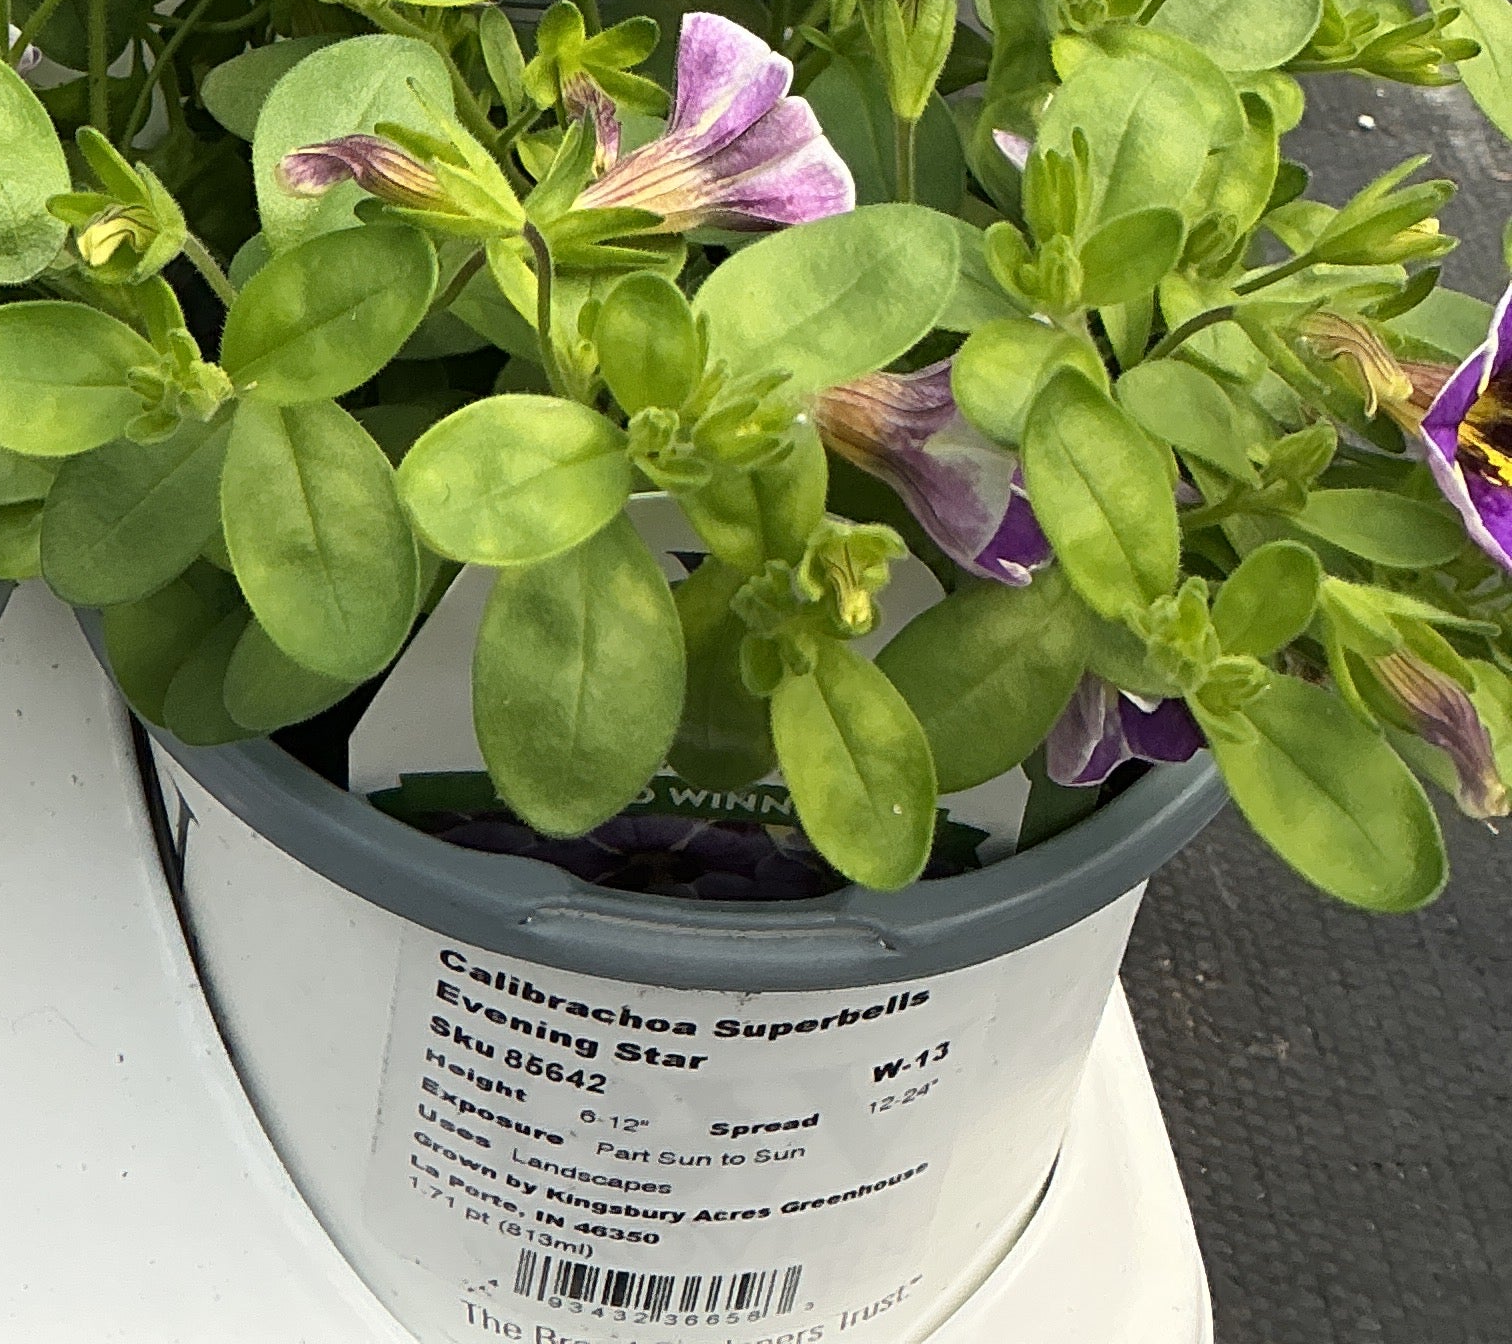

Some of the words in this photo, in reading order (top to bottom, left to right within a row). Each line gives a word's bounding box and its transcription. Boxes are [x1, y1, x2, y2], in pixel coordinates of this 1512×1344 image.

[669, 787, 791, 814] WINN
[436, 979, 599, 1059] Evening
[614, 1042, 708, 1069] Star
[439, 949, 697, 1036] Calibrachoa
[713, 990, 929, 1040] Superbells
[426, 1048, 527, 1102] Height
[709, 1113, 820, 1138] Spread
[430, 1015, 494, 1059] Sku
[504, 1049, 606, 1094] 85642
[873, 1041, 950, 1082] W-13
[418, 1103, 491, 1148] Uses
[512, 1148, 672, 1194] Landscapes
[422, 1076, 564, 1145] Exposure
[595, 1142, 650, 1162] Part
[657, 1152, 712, 1166] Sun
[721, 1153, 746, 1166] to
[754, 1146, 806, 1163] Sun
[411, 1154, 440, 1179] La
[536, 1210, 565, 1228] IN
[573, 1222, 660, 1245] 46350
[414, 1131, 496, 1179] Grown
[506, 1174, 537, 1194] by
[546, 1188, 686, 1223] Kingsbury
[692, 1207, 771, 1222] Acres
[780, 1162, 929, 1214] Greenhouse
[465, 1207, 491, 1224] pt
[499, 1220, 594, 1259] (813ml)
[460, 1300, 522, 1340] The
